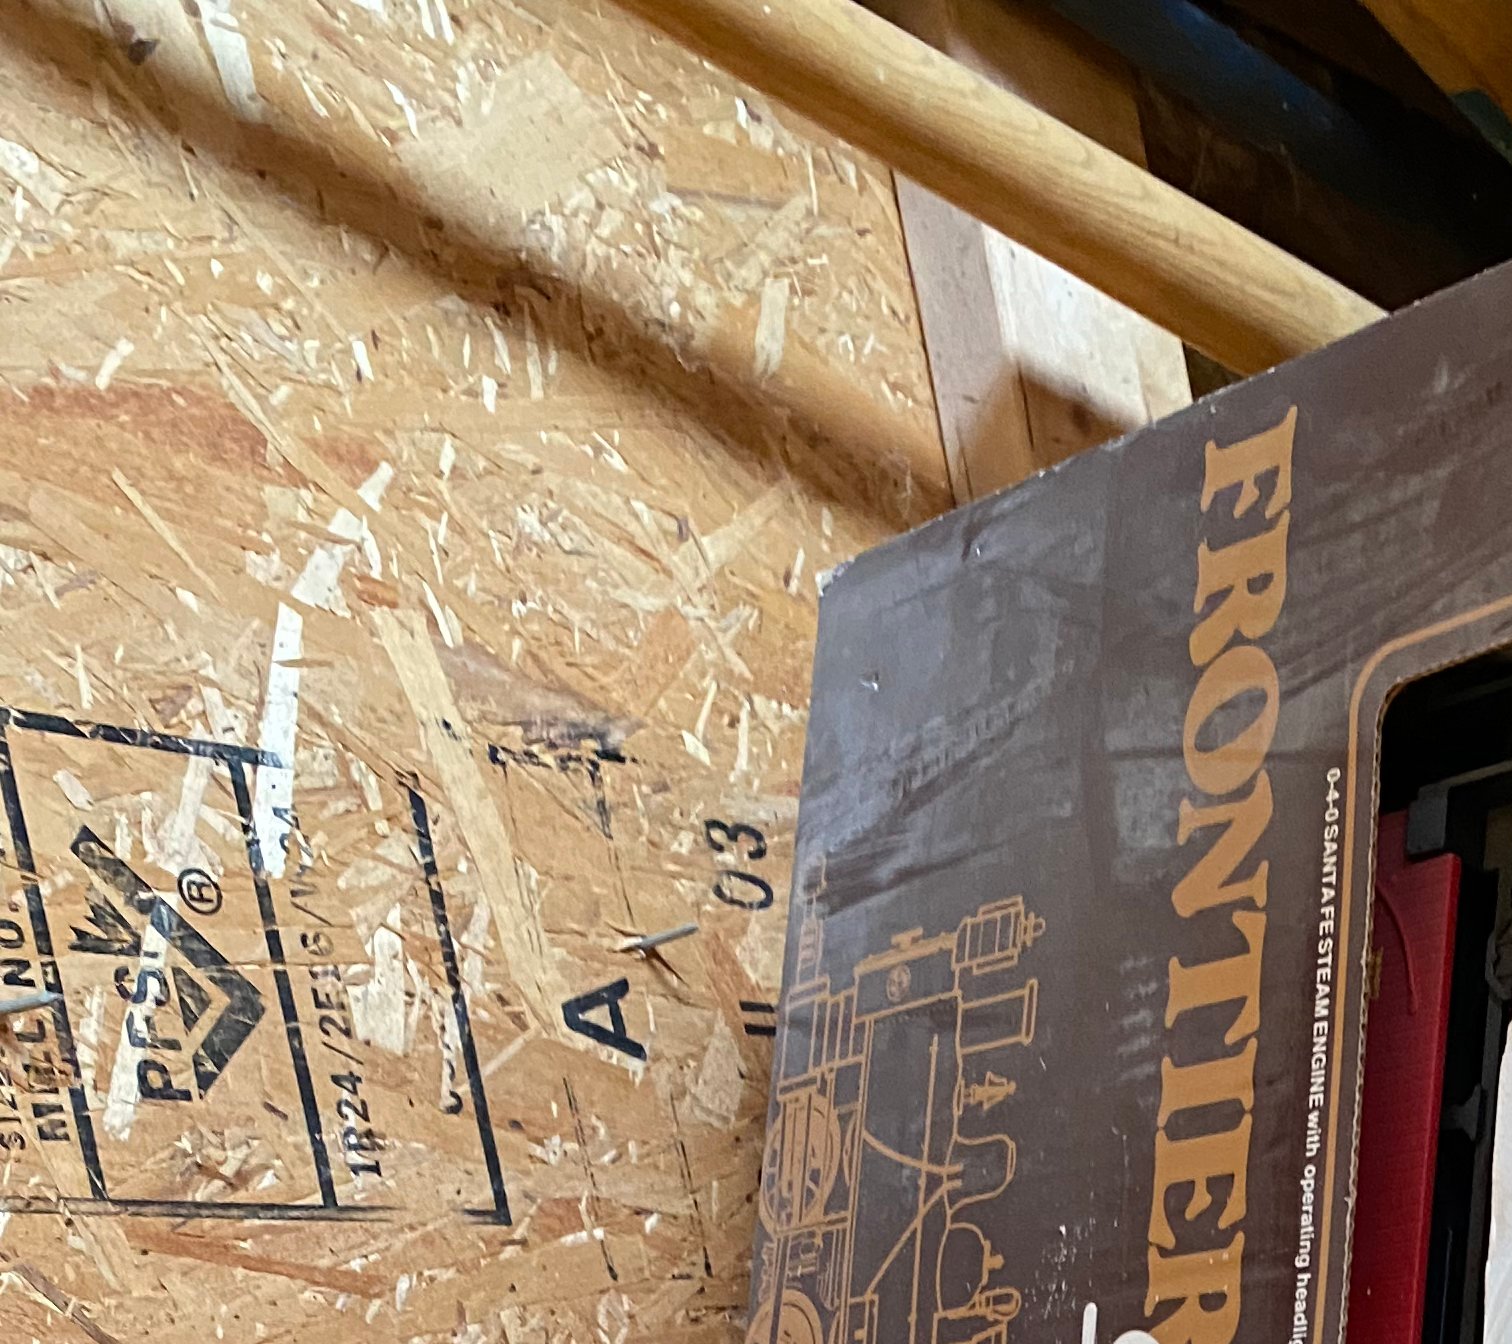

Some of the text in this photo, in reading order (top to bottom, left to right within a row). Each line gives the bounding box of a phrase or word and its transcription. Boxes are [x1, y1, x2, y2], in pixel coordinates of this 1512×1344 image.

[1325, 768, 1340, 822] 0-4-0
[1321, 825, 1338, 908] SANTA
[1315, 938, 1332, 1017] STEAM
[562, 978, 647, 1062] A
[1309, 1021, 1328, 1108] ENGINE
[1306, 1111, 1321, 1157] with
[1295, 1165, 1315, 1268] operating
